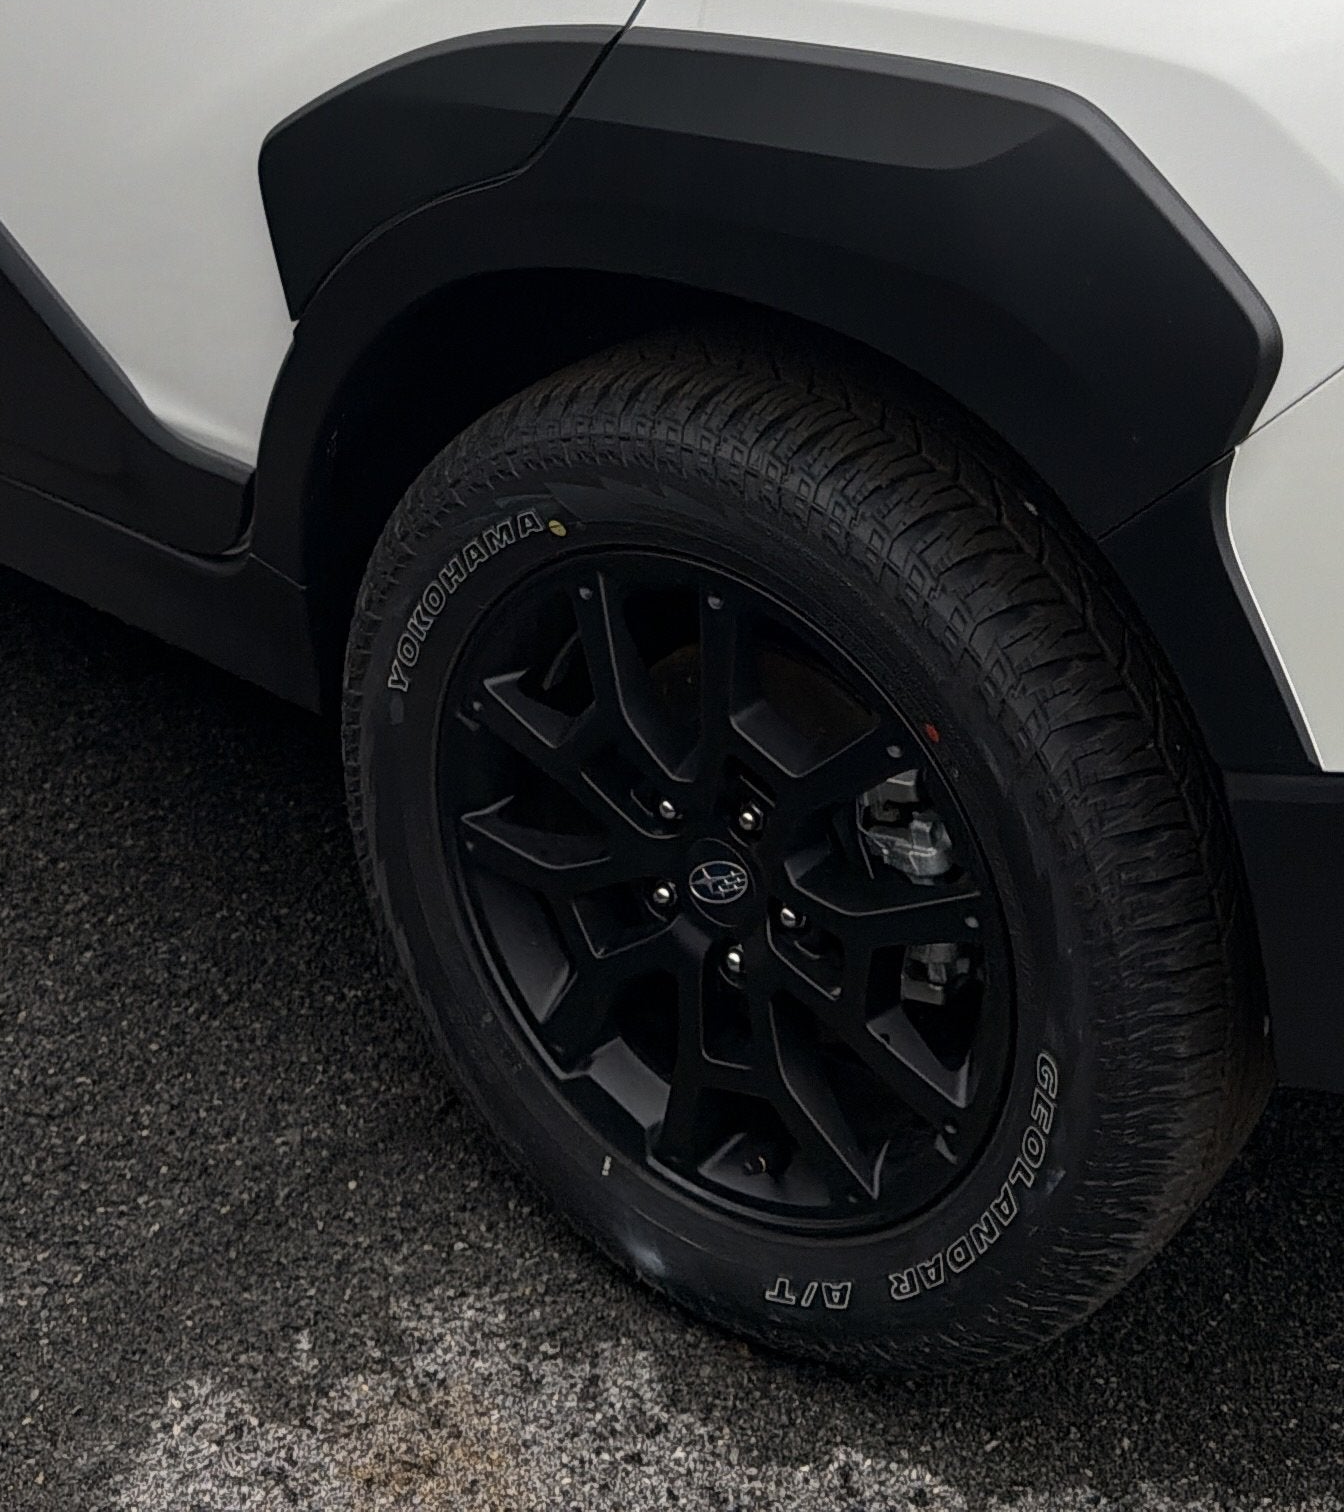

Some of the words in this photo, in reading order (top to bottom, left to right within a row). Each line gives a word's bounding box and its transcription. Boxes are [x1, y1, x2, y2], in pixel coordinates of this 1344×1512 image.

[387, 509, 545, 694] YOKOHAMA
[888, 1051, 1058, 1301] GEOLANDAR
[764, 1277, 852, 1310] A/T
